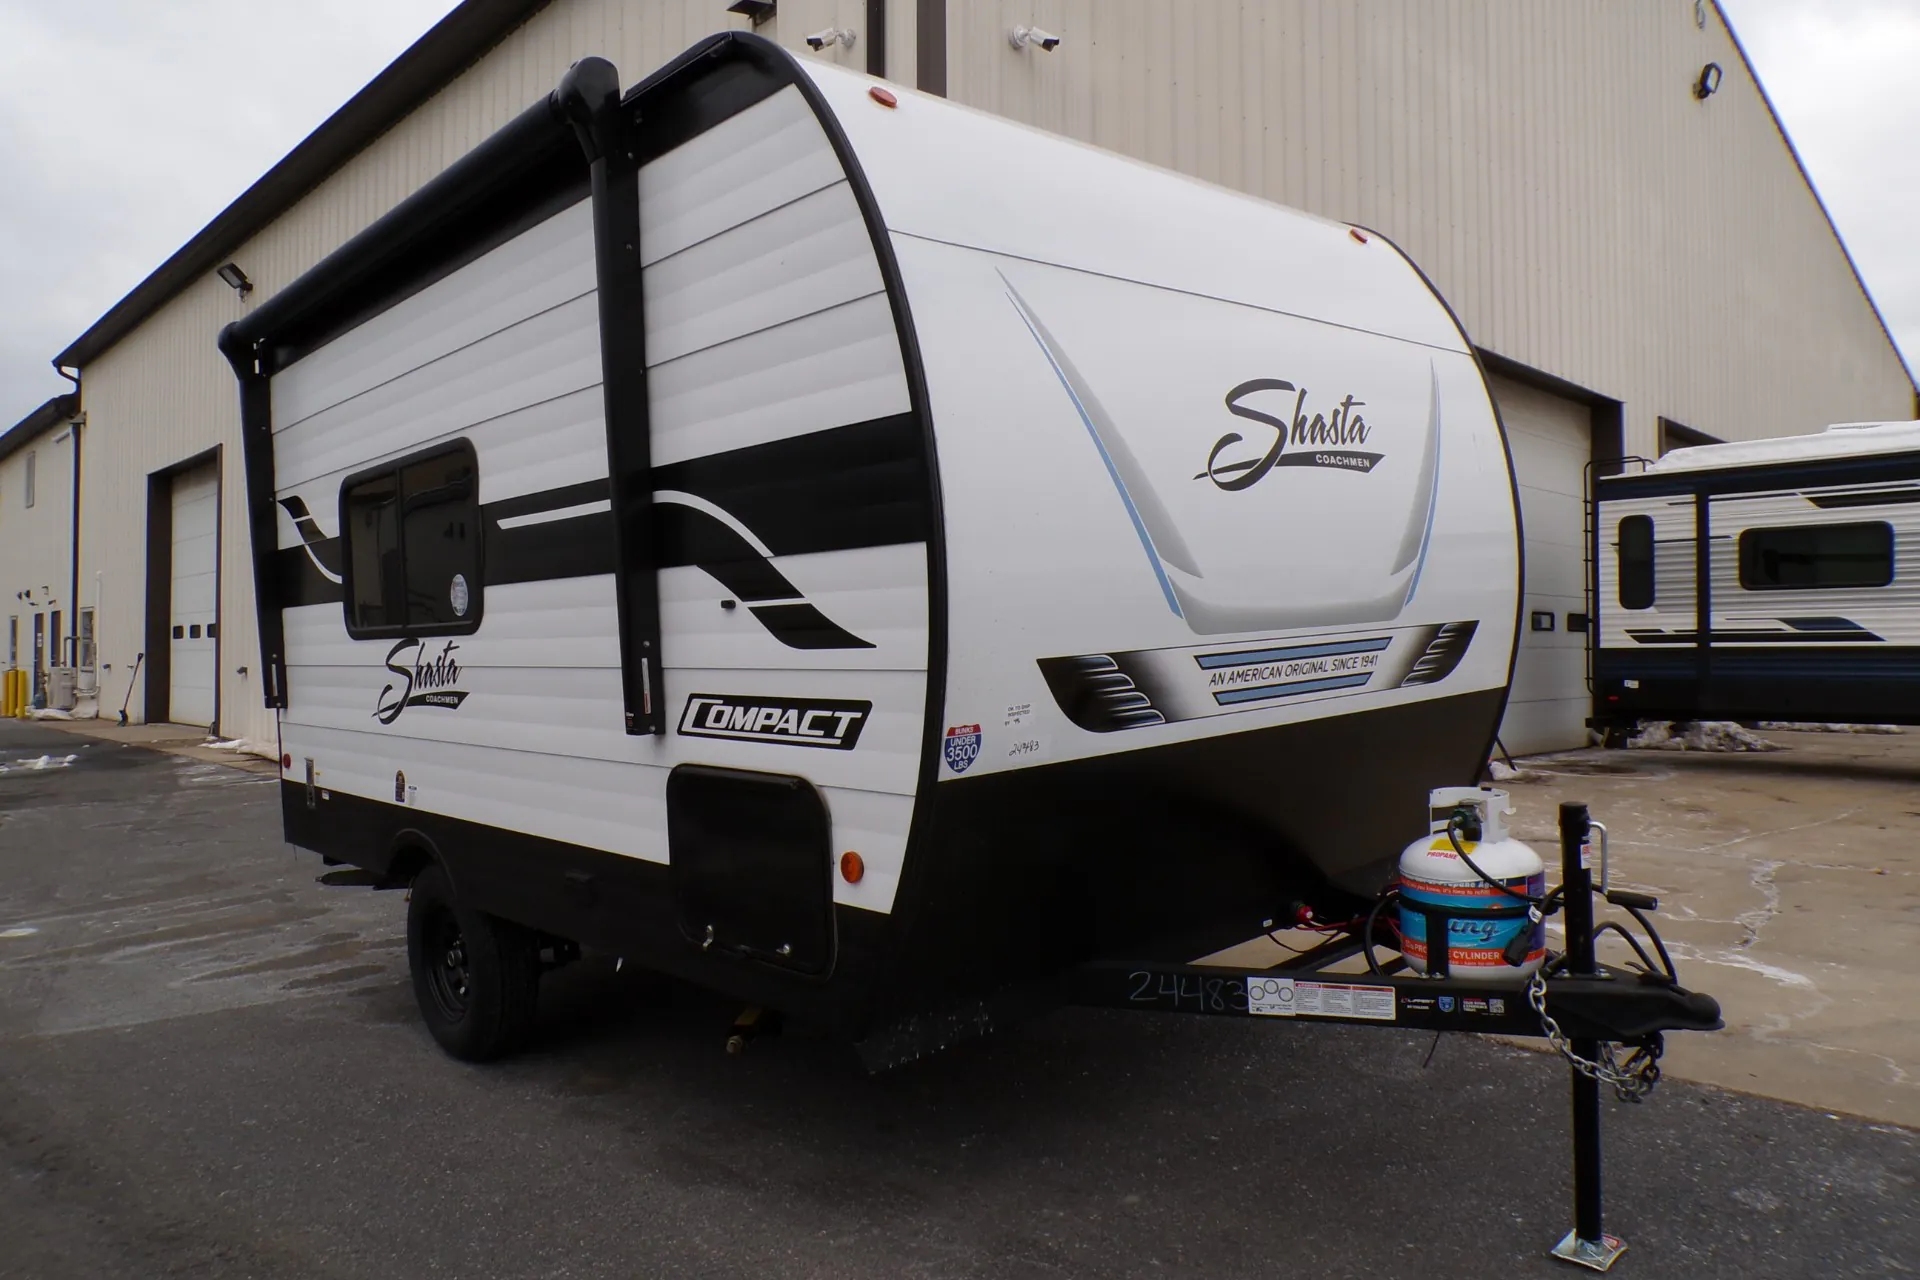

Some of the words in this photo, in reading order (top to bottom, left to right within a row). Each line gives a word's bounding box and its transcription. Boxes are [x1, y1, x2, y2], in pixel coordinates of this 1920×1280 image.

[1207, 378, 1372, 492] Shasta
[1315, 453, 1370, 468] COACHMEN
[1208, 671, 1226, 687] AN
[1227, 666, 1283, 684] AMERICAN
[1284, 660, 1328, 677] ORIGINAL
[1331, 656, 1359, 672] SINCE
[1360, 654, 1379, 668] 1941
[377, 638, 462, 725] Shasta
[425, 695, 459, 705] COACHMEN
[681, 698, 863, 745] COMPACT
[950, 736, 976, 747] UNDER
[947, 744, 978, 762] 3500
[954, 760, 969, 770] LBS
[1426, 851, 1458, 860] PROPANE
[1448, 918, 1498, 942] ing
[1453, 950, 1500, 960] CYLINDER
[1128, 971, 1249, 1012] 24483
